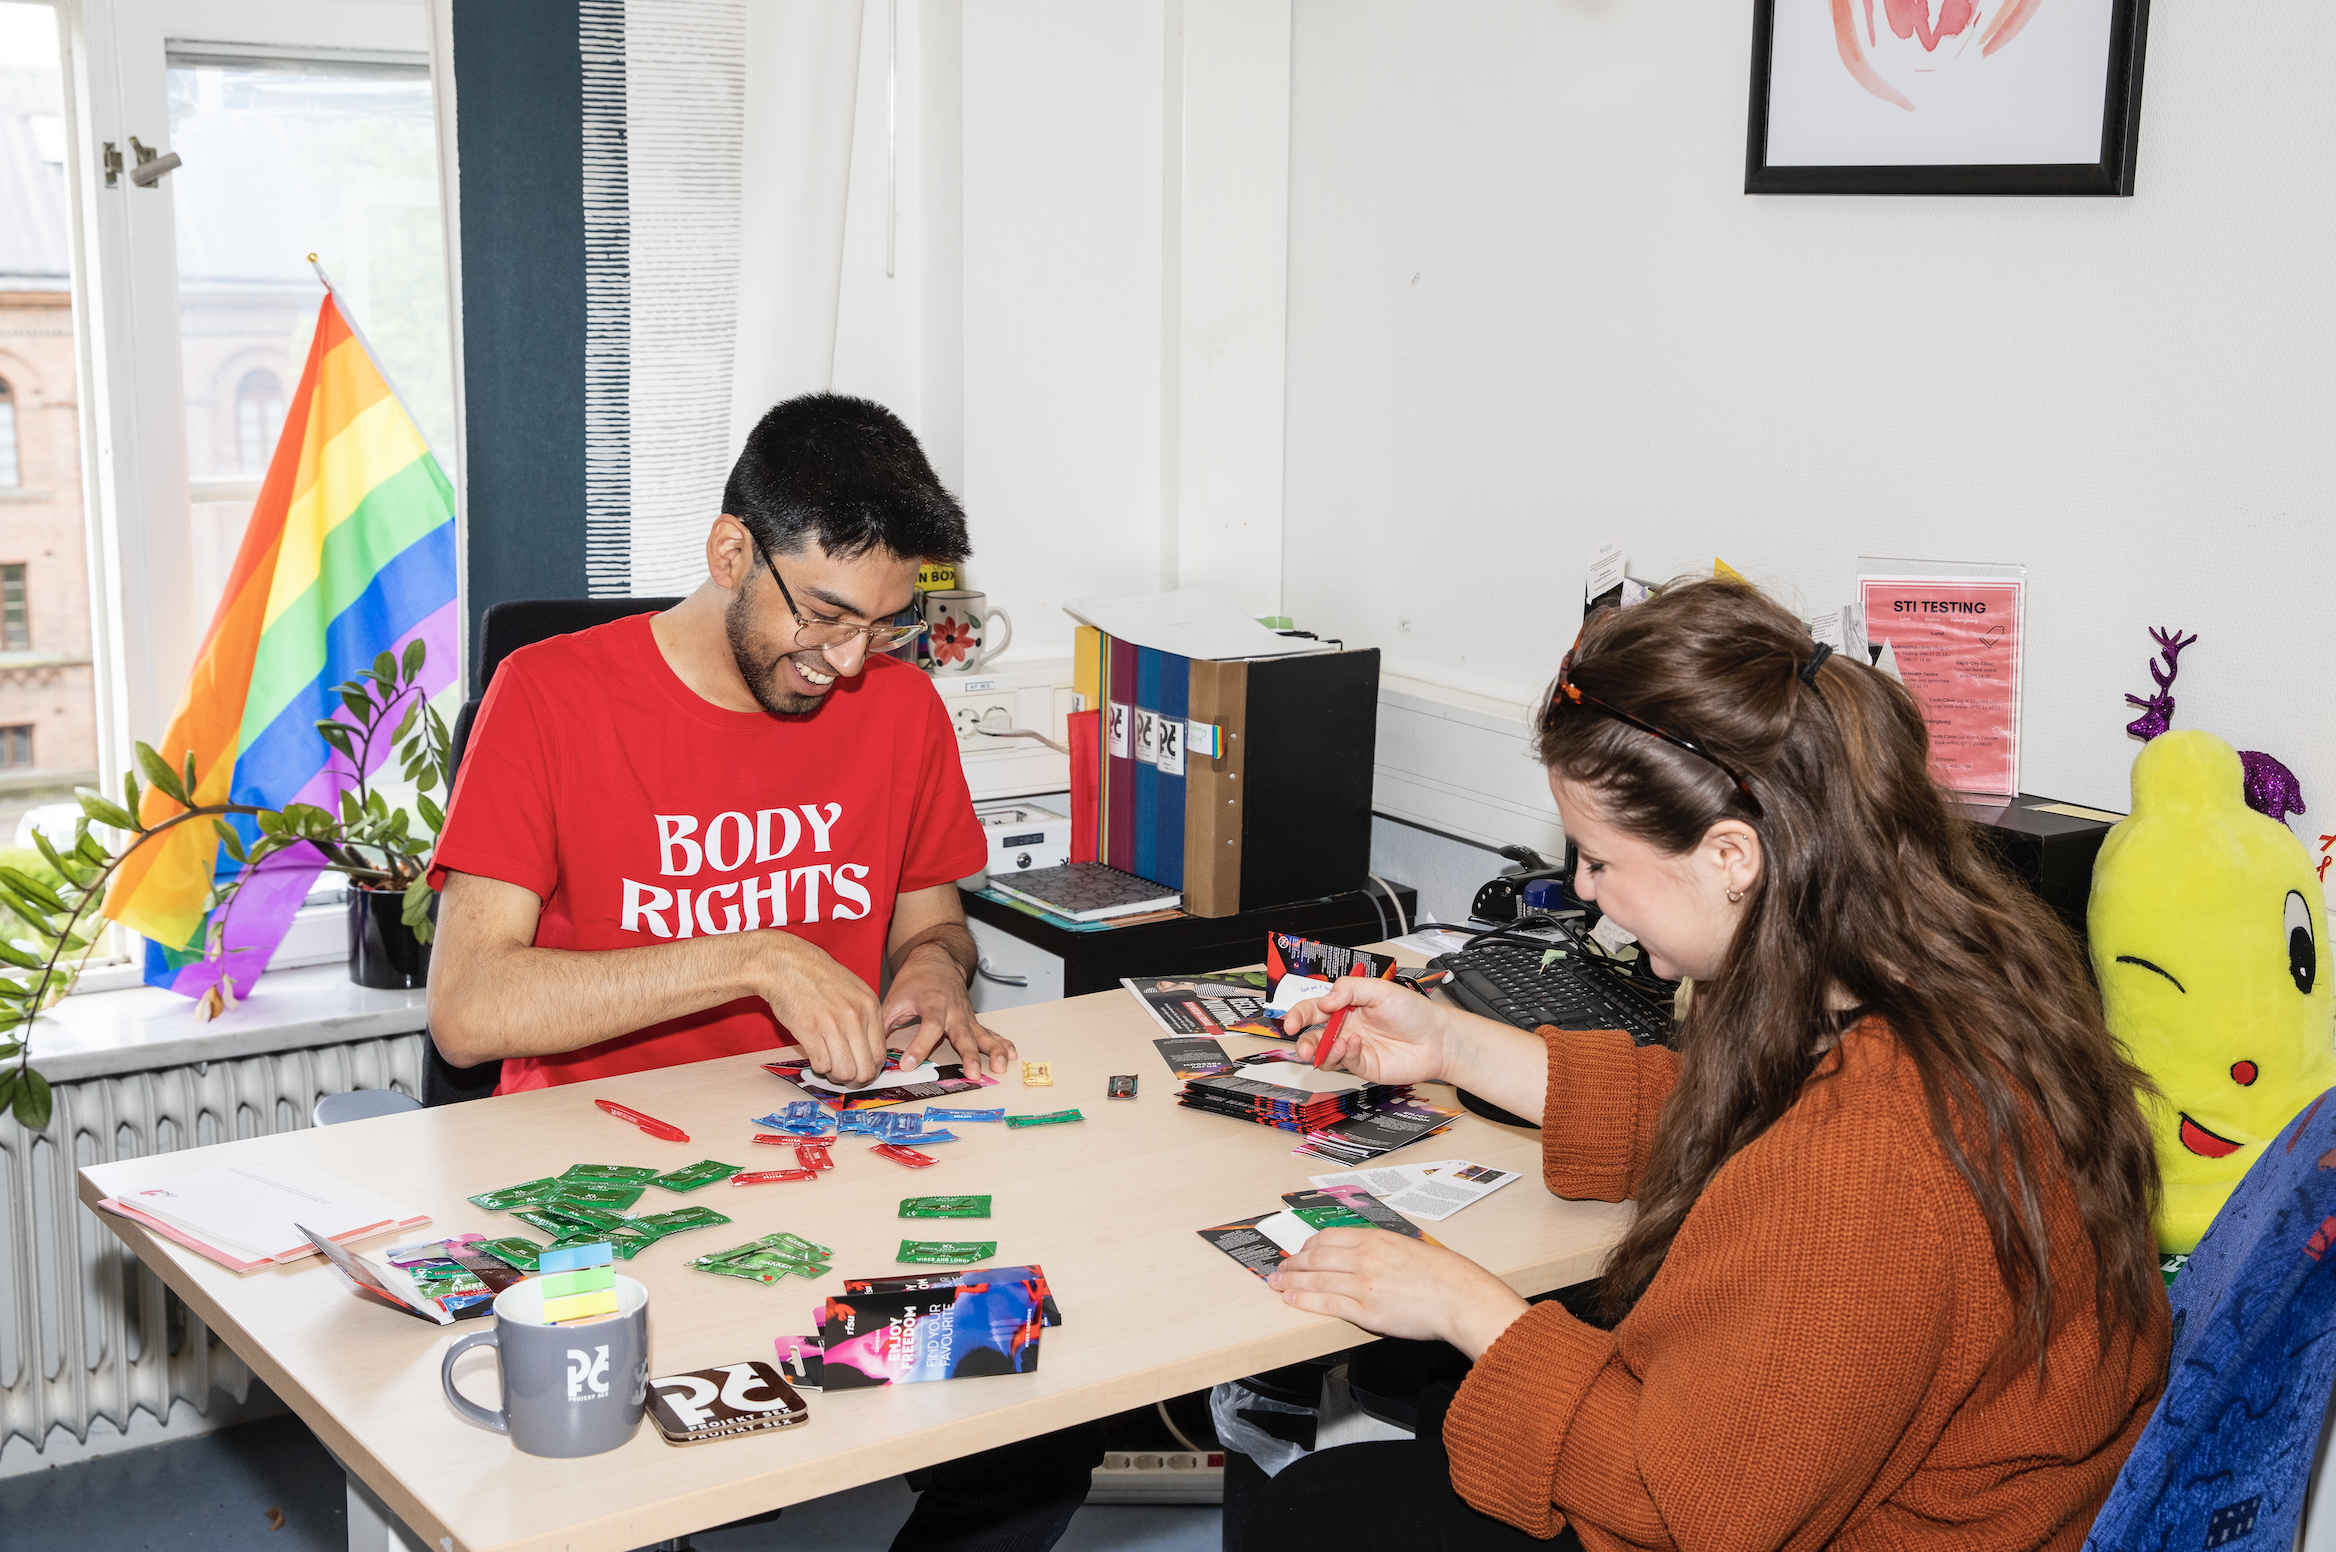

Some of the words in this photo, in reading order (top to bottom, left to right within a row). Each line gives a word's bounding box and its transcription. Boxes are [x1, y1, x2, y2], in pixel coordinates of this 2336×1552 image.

[1893, 600, 1917, 612] STI
[1921, 601, 1987, 614] TESTING
[654, 802, 842, 876] BODY
[620, 863, 871, 938] RIGHTS
[845, 1315, 855, 1335] rfsu
[928, 1303, 941, 1339] YOUR
[939, 1302, 955, 1367] FAVOURITE
[888, 1316, 902, 1362] ENJOY
[901, 1305, 917, 1370] FREEDOM
[926, 1340, 939, 1368] FIND
[567, 1394, 596, 1402] PROJEKT
[597, 1391, 610, 1399] SEX
[687, 1414, 755, 1432] PROJEKT
[762, 1407, 792, 1418] SEX
[762, 1418, 793, 1428] SEX
